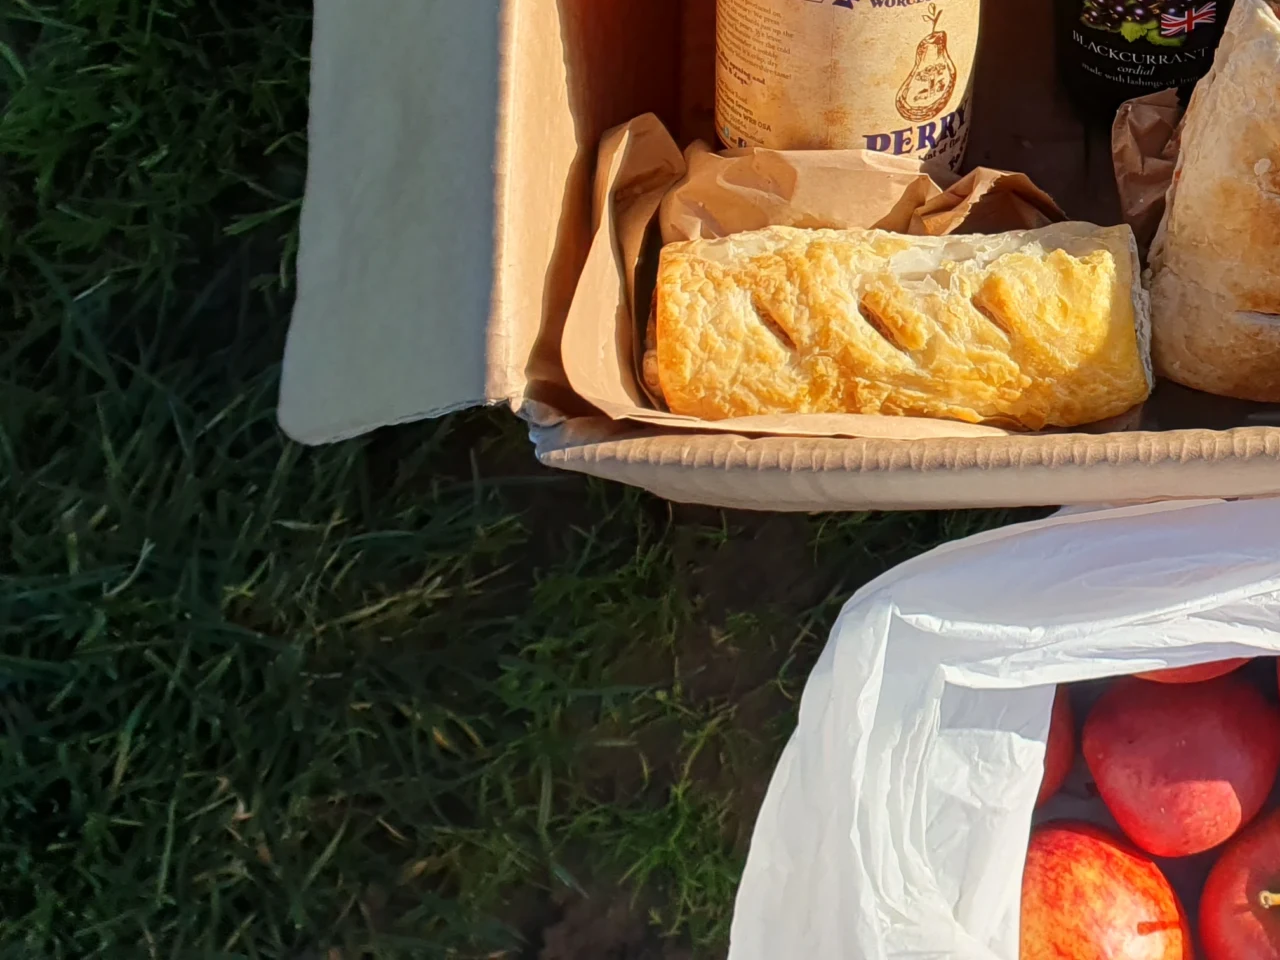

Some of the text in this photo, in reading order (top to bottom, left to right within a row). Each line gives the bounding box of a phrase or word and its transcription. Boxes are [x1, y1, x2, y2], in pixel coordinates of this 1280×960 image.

[1072, 30, 1209, 65] BLACKCURRANT
[1082, 62, 1102, 77] made
[1105, 72, 1125, 84] with
[1127, 75, 1163, 89] lashings
[1117, 65, 1155, 76] cordial
[862, 96, 969, 156] PERRY
